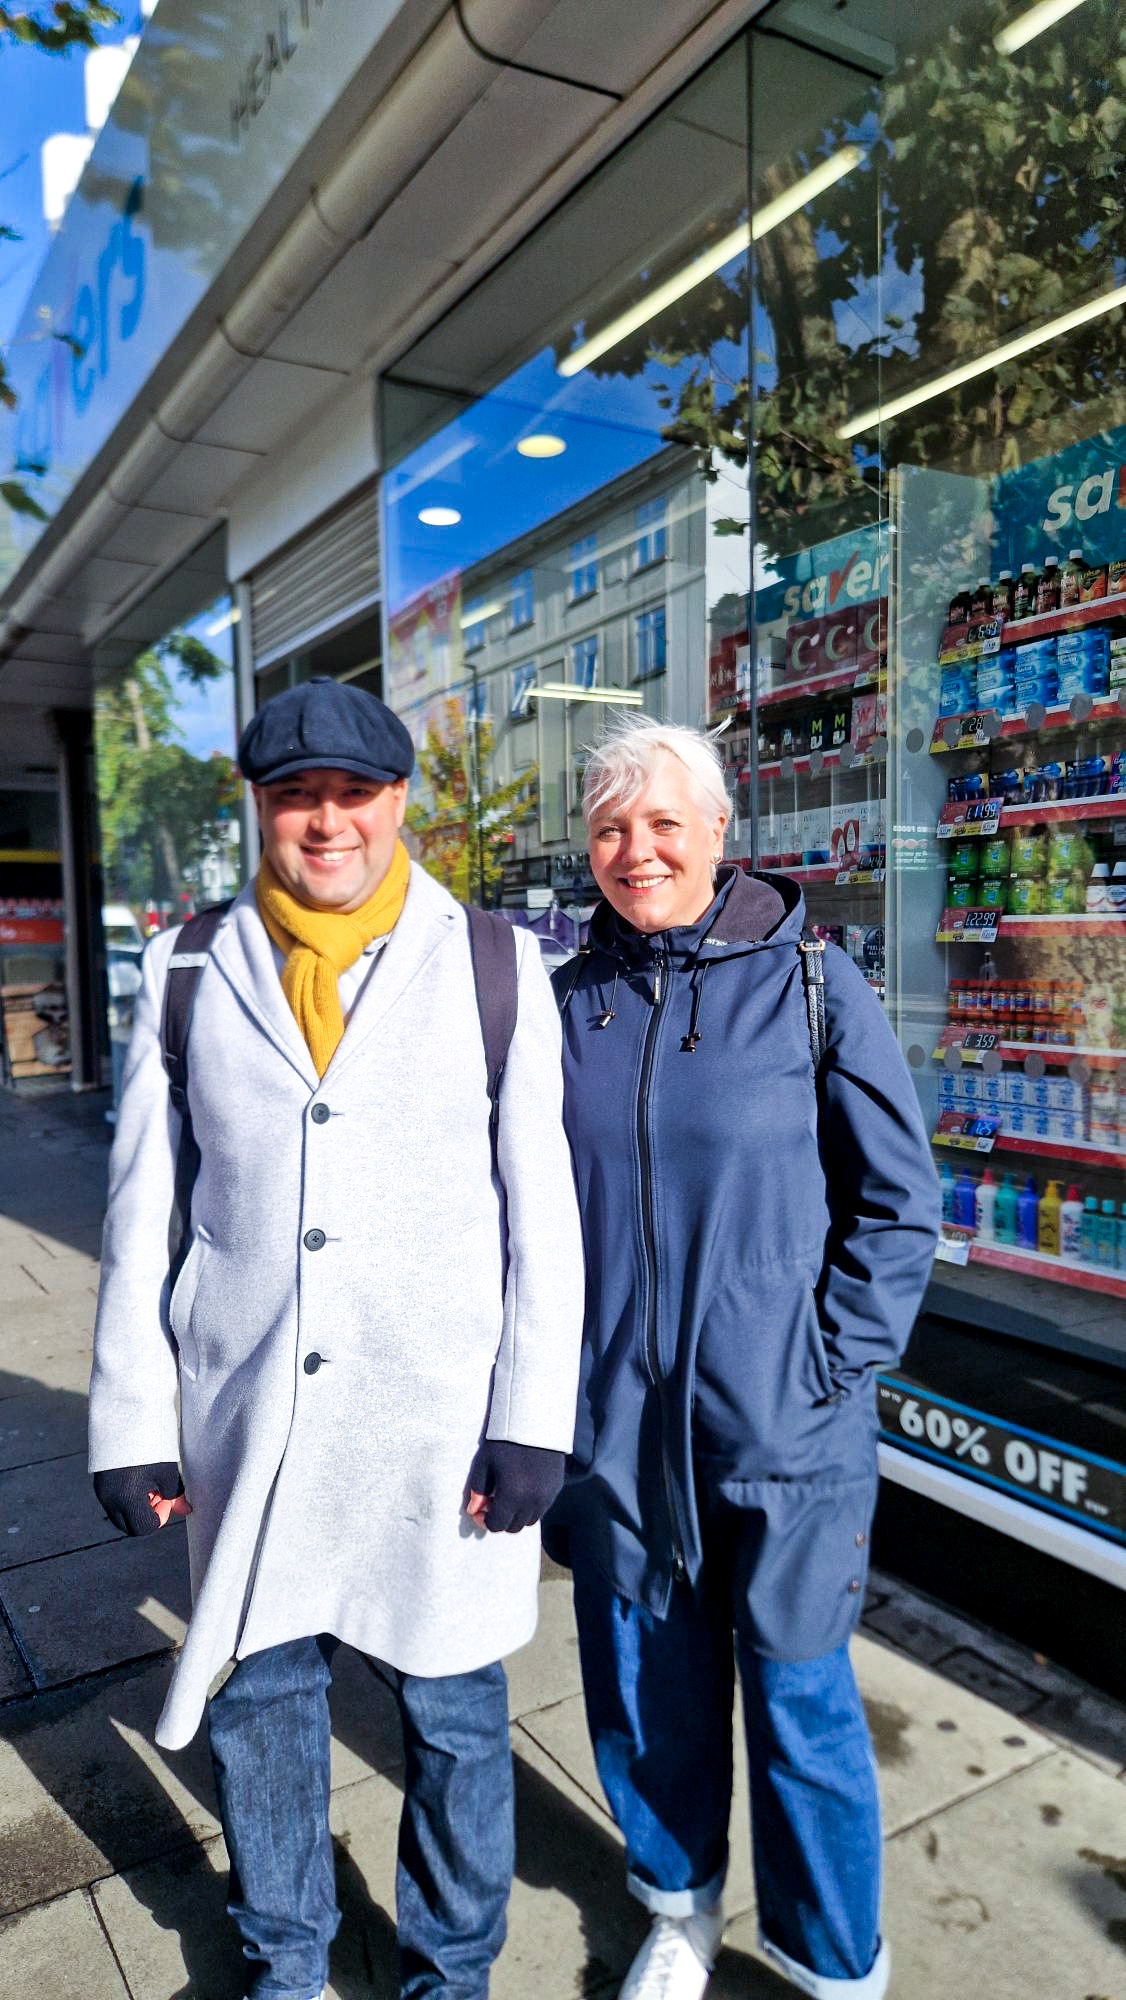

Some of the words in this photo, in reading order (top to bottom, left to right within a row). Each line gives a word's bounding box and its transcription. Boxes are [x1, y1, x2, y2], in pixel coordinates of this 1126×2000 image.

[966, 912, 996, 926] £22.99
[900, 1399, 991, 1465] 60%
[1004, 1440, 1089, 1503] OFF
